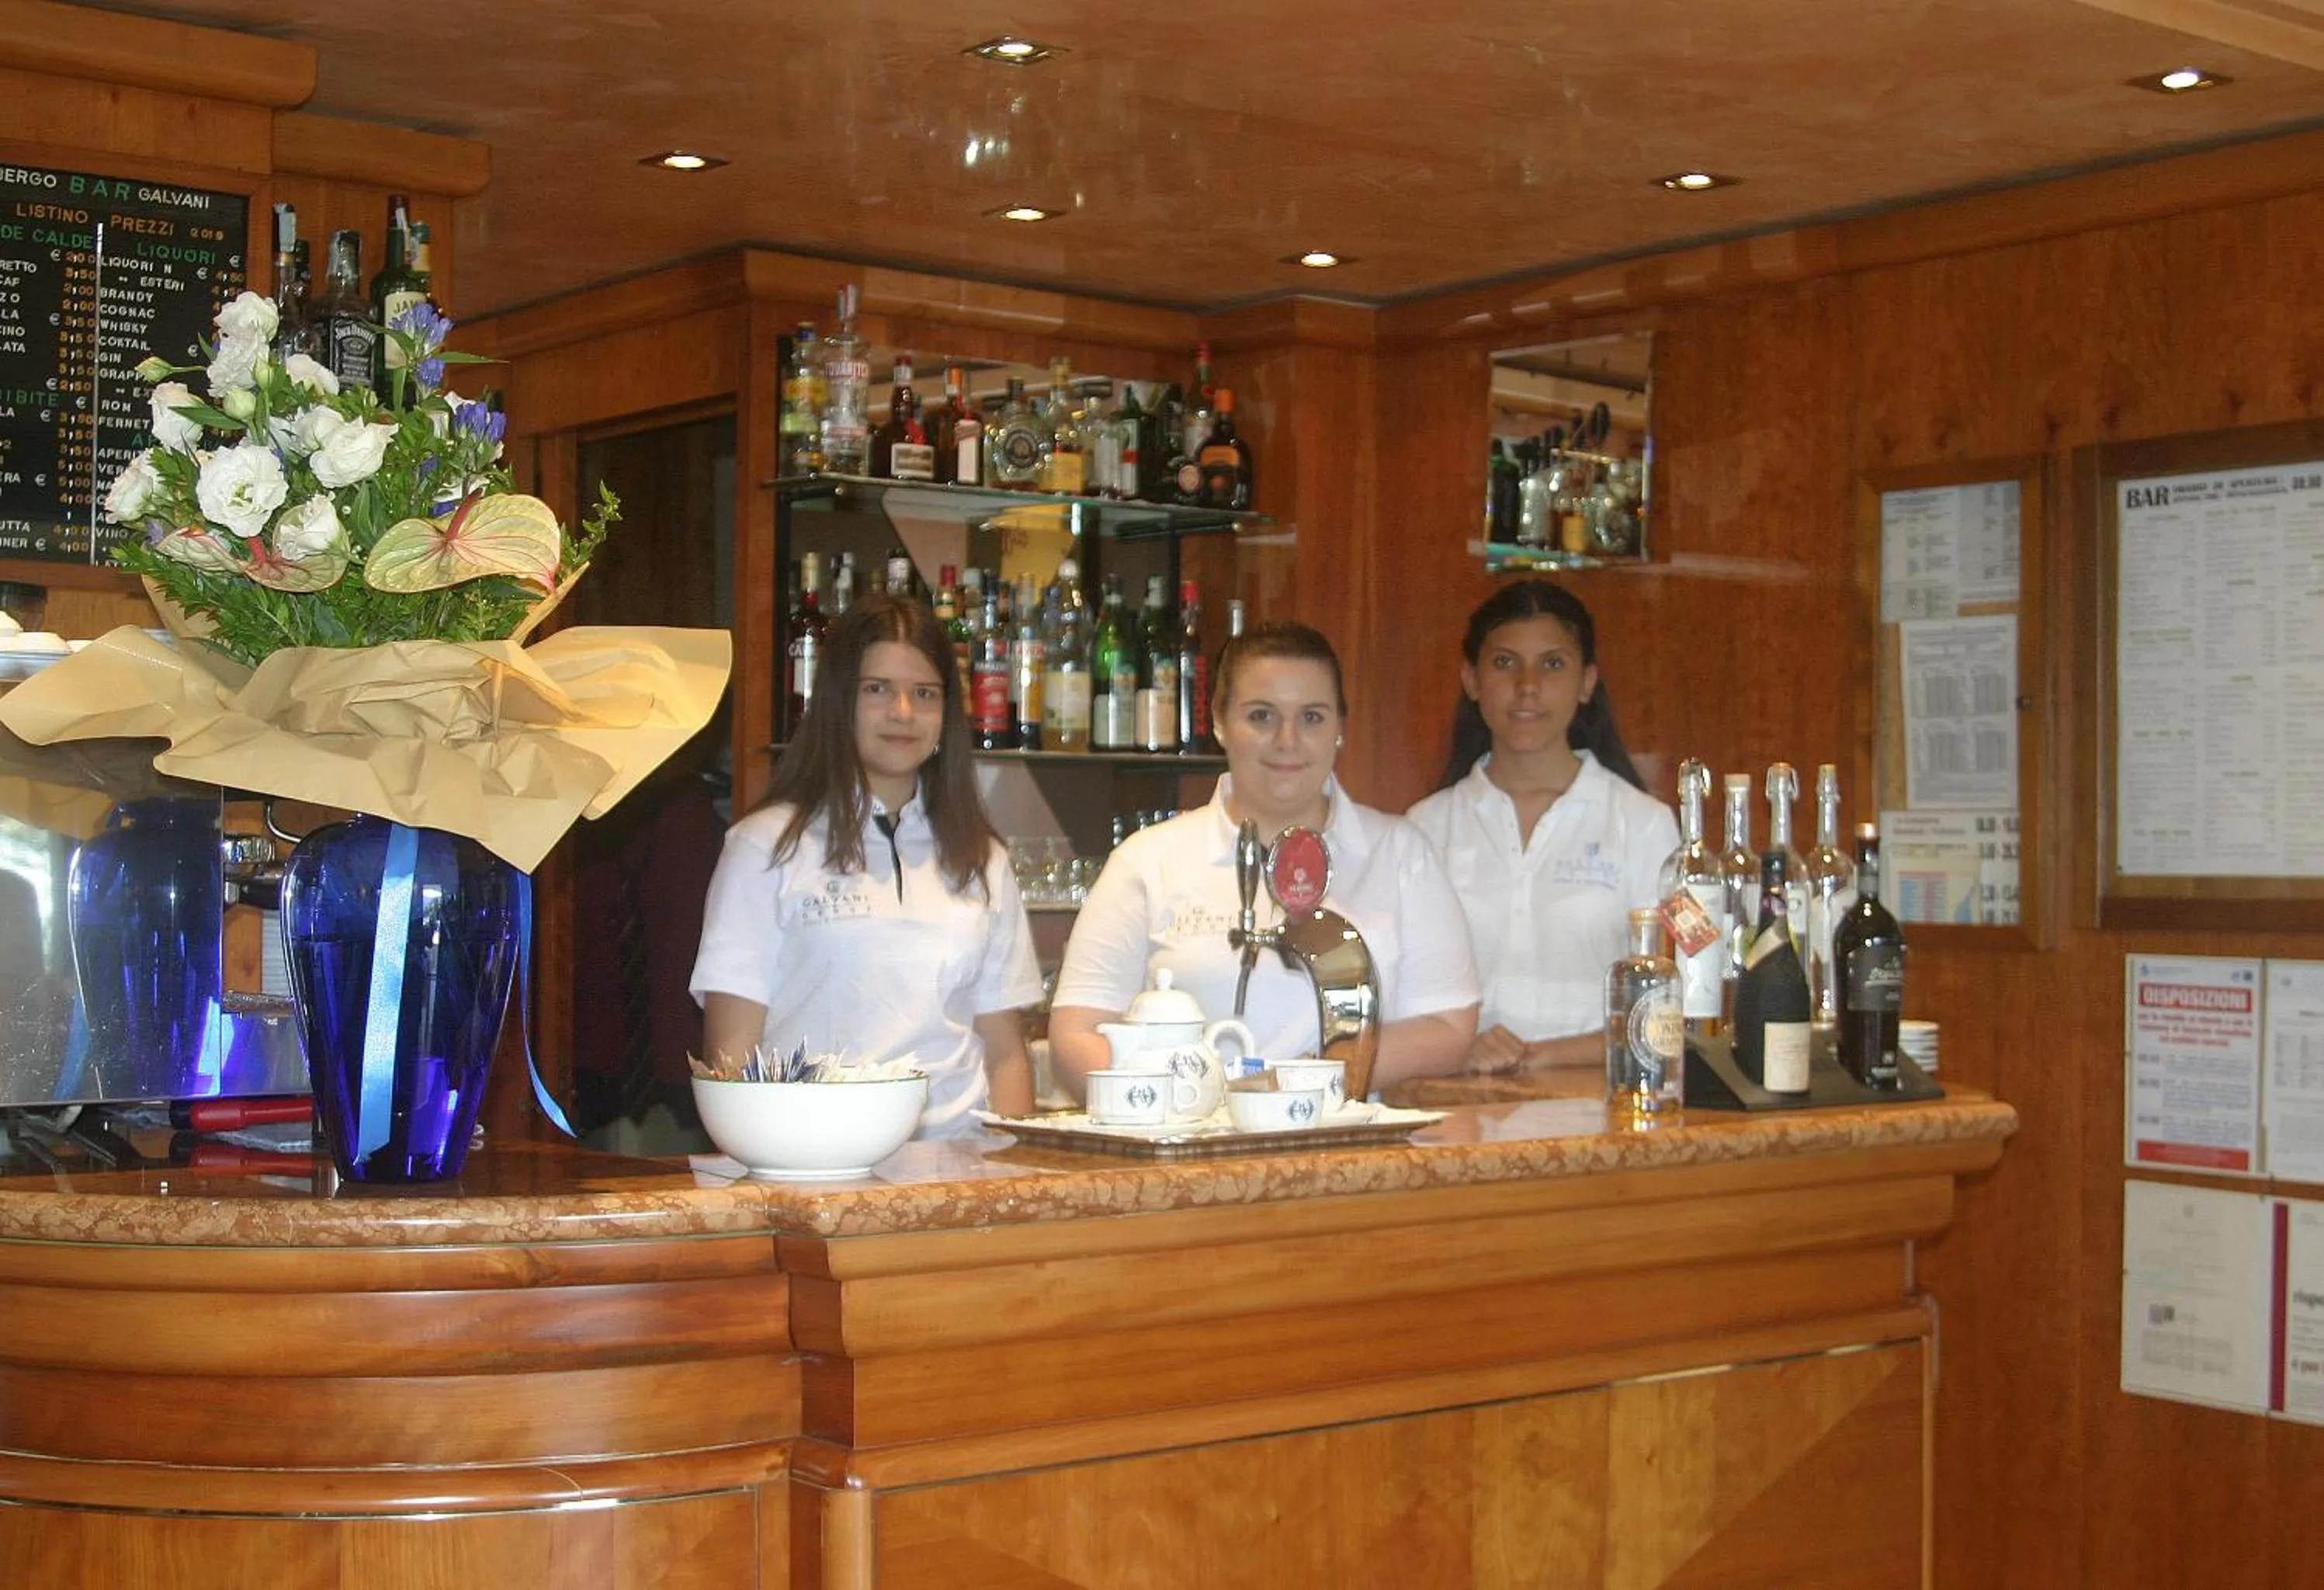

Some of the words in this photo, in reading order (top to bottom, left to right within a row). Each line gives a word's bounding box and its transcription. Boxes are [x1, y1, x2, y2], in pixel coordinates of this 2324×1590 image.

[70, 175, 130, 201] BAR
[138, 187, 210, 210] GALVANI
[16, 202, 88, 224] LISTINO
[110, 214, 174, 235] PREZZI
[33, 229, 94, 249] CALDE
[137, 242, 216, 265] LIQUORI
[101, 256, 154, 273] LIQUORI
[140, 276, 185, 292] ESTERI
[99, 288, 154, 303] BRANDY
[99, 304, 155, 319] COGNAC
[0, 326, 26, 337] INO
[99, 319, 148, 334] WHISKY
[0, 341, 26, 353] ATA
[99, 335, 151, 351] COKTAIL
[99, 352, 122, 363] GIN
[0, 389, 60, 408] IBITE
[98, 416, 151, 430] FERNET
[2126, 485, 2170, 509] BAR
